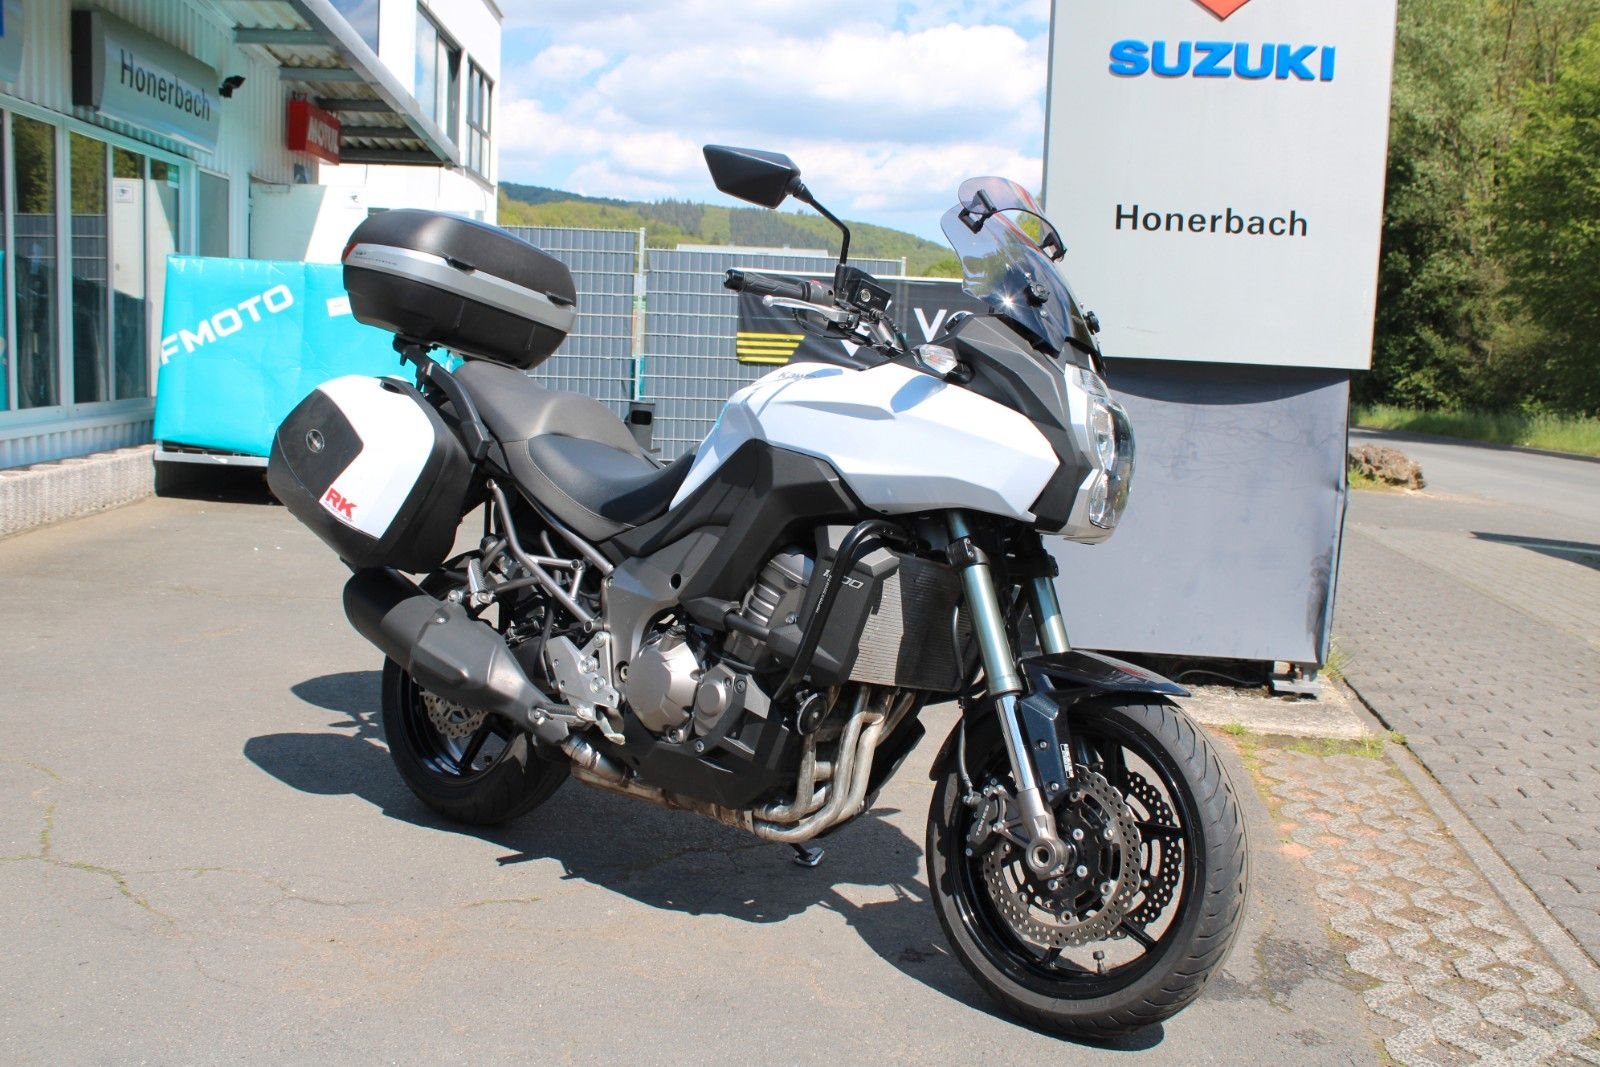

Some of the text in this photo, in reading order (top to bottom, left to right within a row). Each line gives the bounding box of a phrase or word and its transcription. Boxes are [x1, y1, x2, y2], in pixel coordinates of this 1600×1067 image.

[1108, 39, 1336, 82] SUZUKI
[120, 48, 210, 121] Honerbach
[1115, 204, 1308, 237] Honerbach
[325, 487, 358, 519] RK
